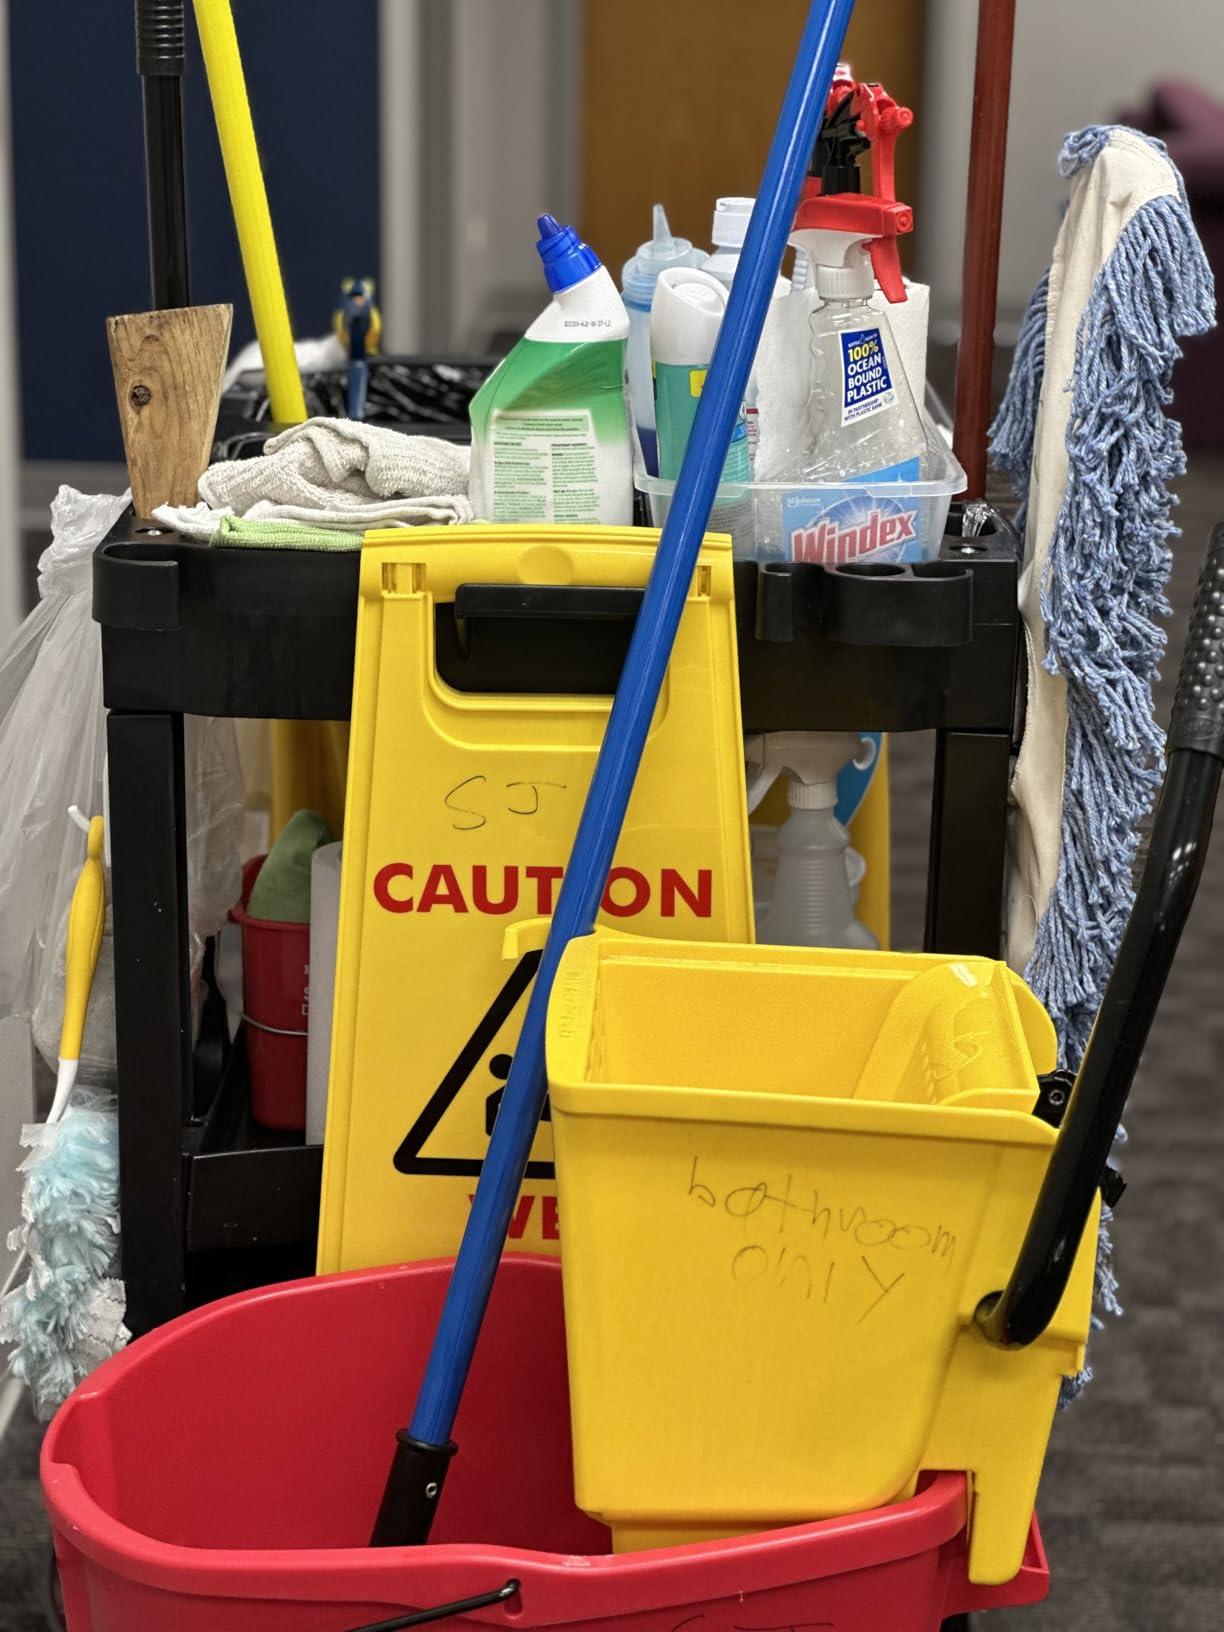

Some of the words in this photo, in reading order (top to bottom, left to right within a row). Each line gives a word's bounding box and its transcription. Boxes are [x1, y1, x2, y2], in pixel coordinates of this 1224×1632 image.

[848, 339, 879, 362] 100%
[847, 352, 882, 376] OCEAN
[847, 376, 887, 402] PLASTIC
[848, 366, 882, 389] BOUND
[792, 510, 917, 563] Windex
[373, 862, 713, 918] CAUTON
